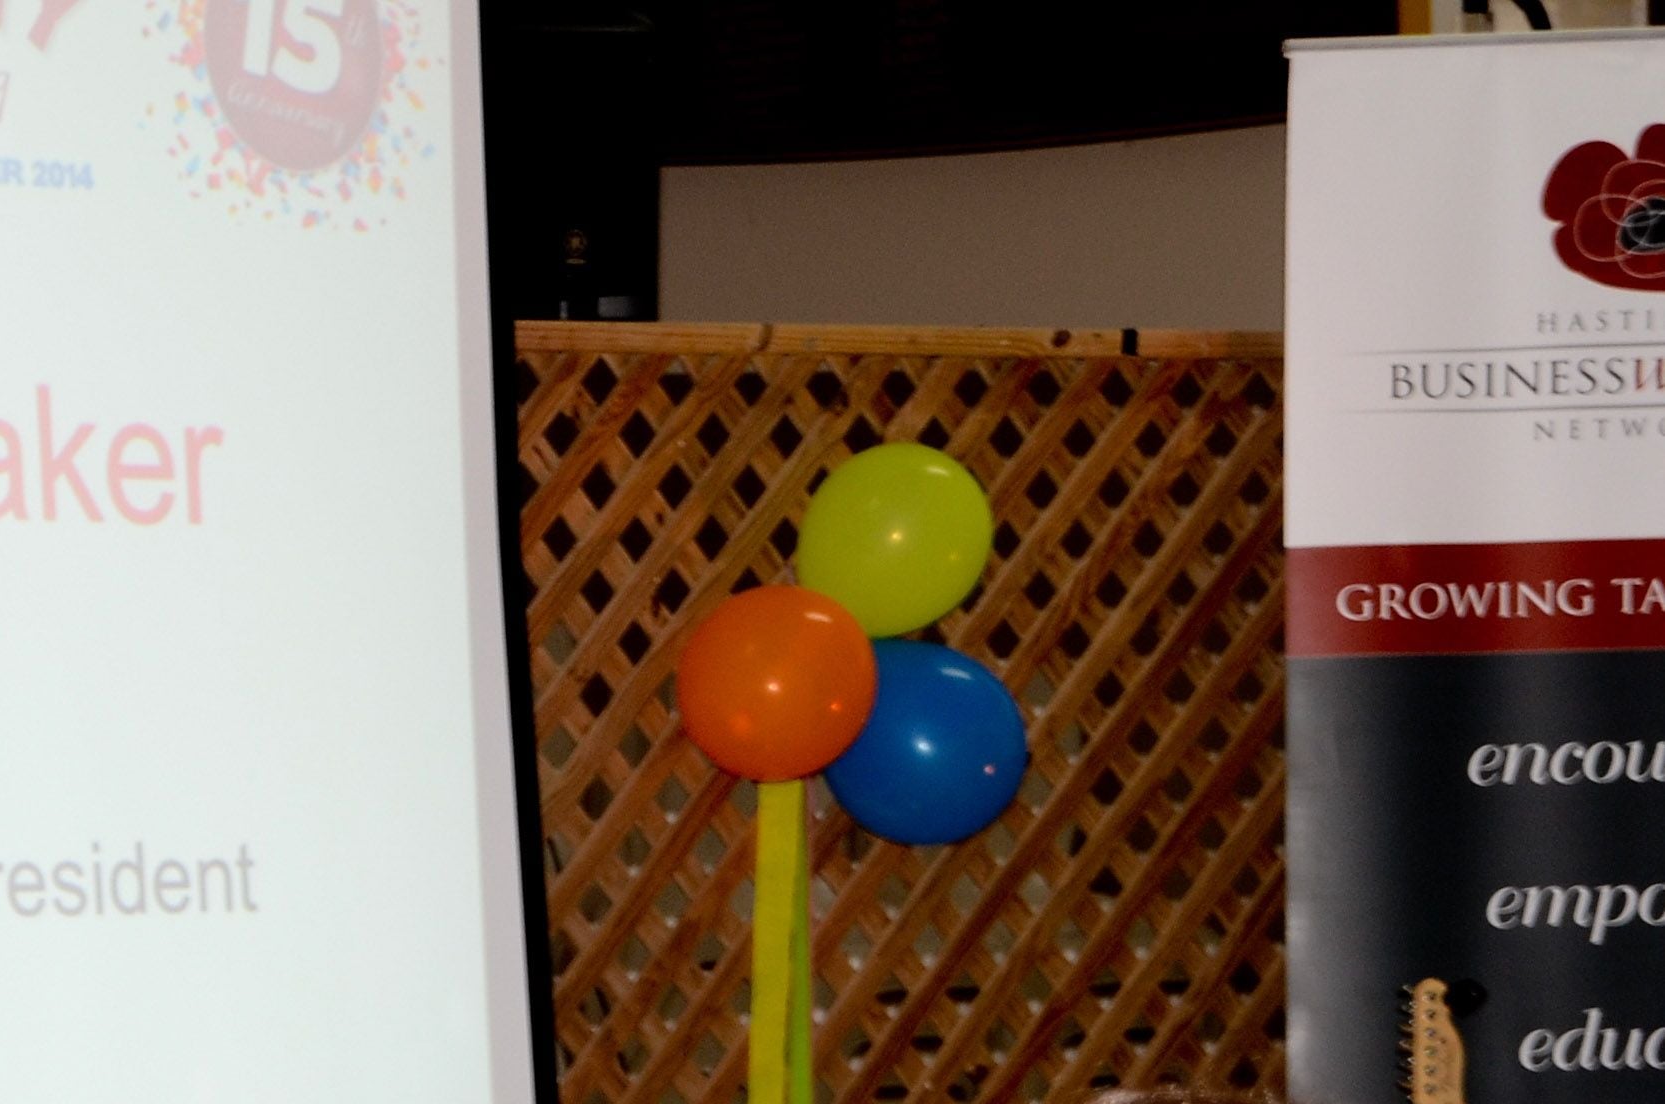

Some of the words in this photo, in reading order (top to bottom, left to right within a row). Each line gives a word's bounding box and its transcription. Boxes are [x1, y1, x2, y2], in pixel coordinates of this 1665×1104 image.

[31, 159, 96, 190] 2014
[1335, 578, 1595, 621] GROWING
[1467, 740, 1665, 787] encou
